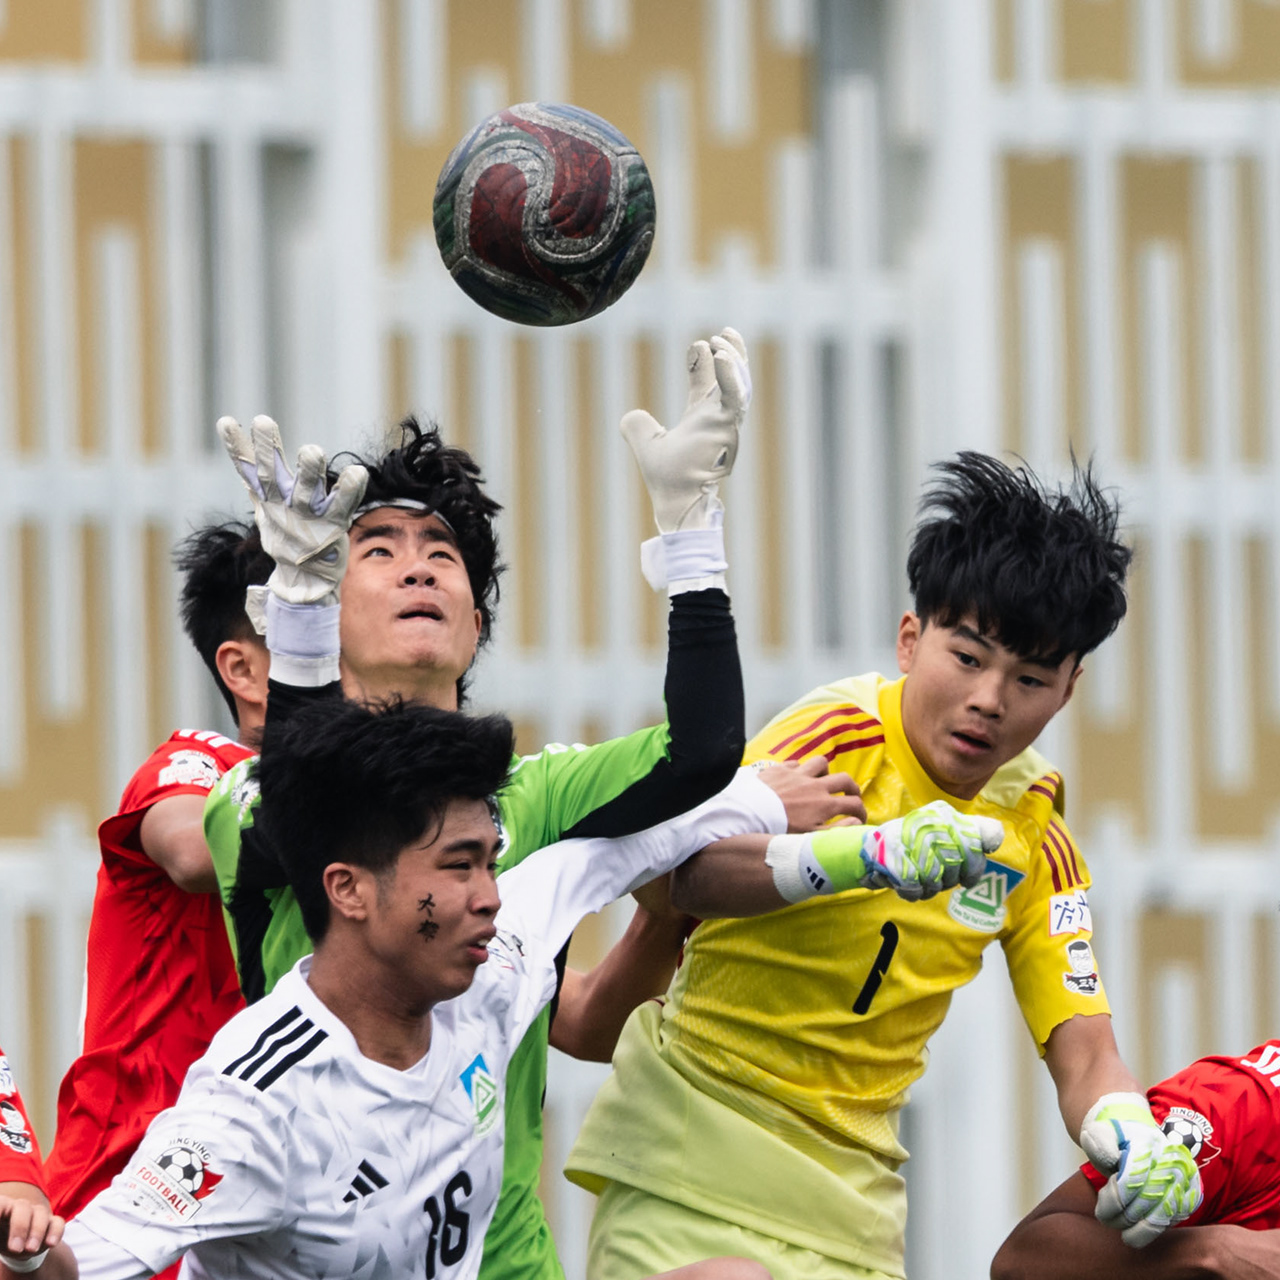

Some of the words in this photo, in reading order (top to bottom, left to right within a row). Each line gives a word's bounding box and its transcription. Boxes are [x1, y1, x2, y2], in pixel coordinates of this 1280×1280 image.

[852, 922, 899, 1015] 1
[1194, 1113, 1212, 1134] YING
[192, 1140, 211, 1161] YING
[135, 1166, 189, 1216] FOOTBALL
[423, 1170, 474, 1280] 16
